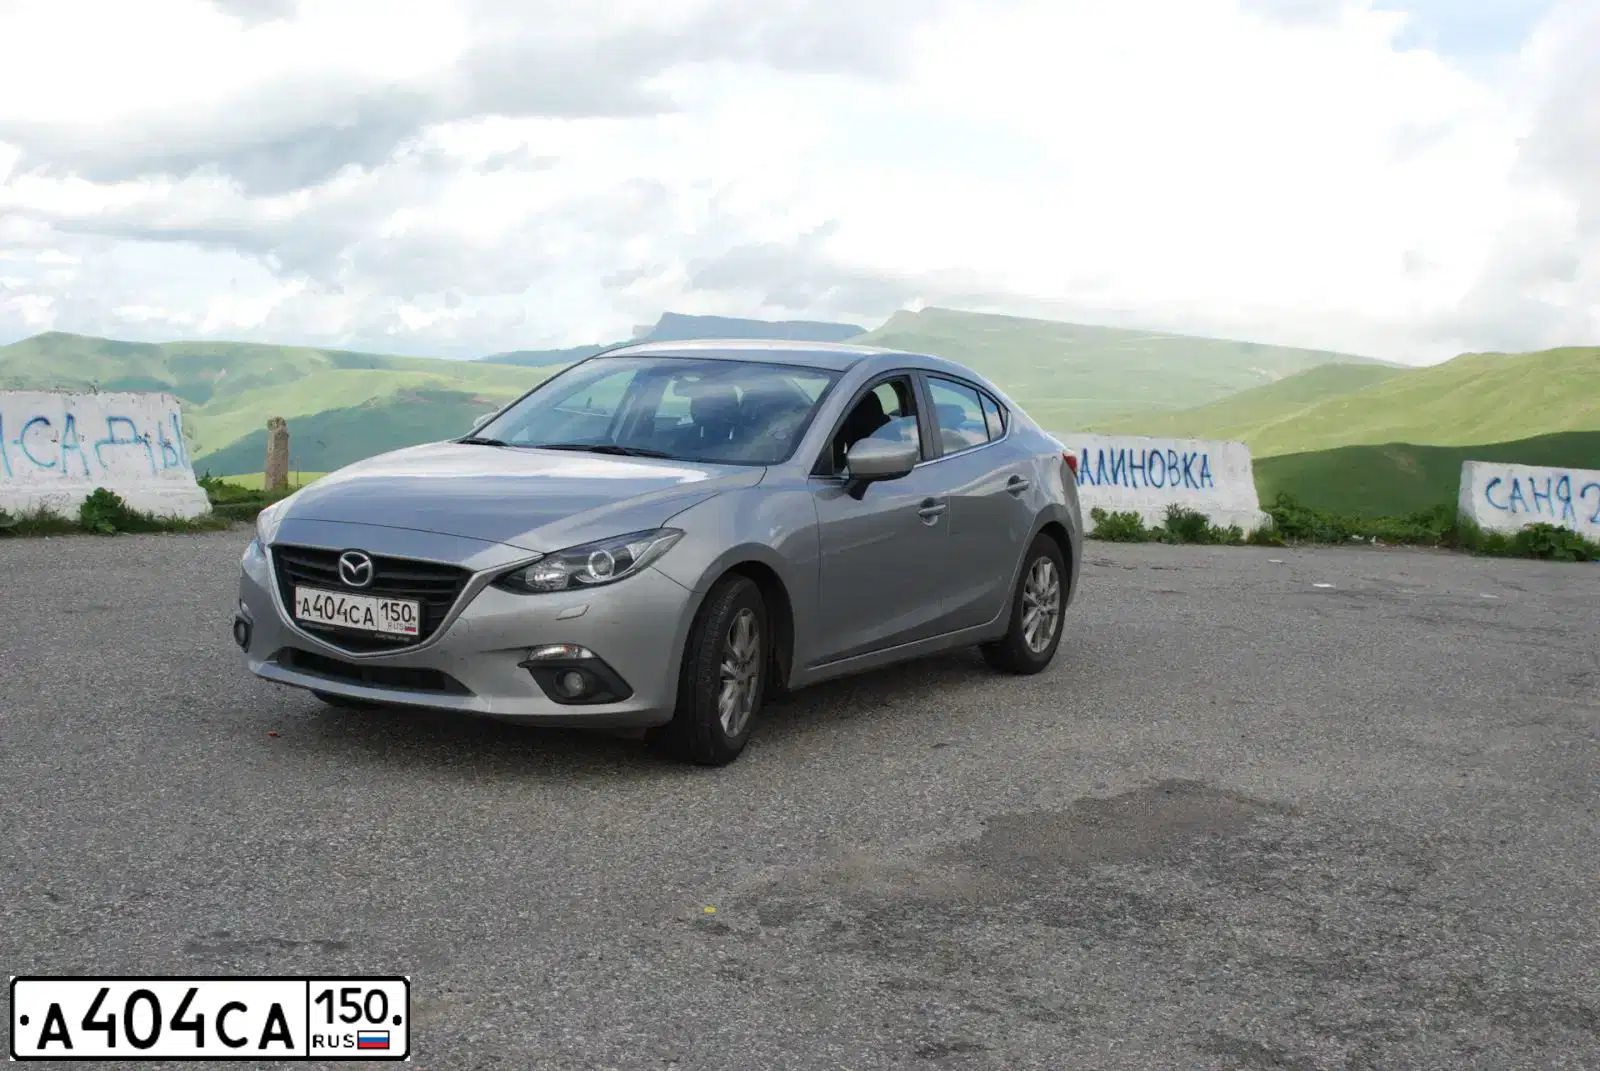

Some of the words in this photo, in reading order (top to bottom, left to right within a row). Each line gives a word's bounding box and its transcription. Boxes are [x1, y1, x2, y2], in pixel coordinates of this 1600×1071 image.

[1076, 448, 1214, 489] АЛИНОВКА
[1485, 475, 1577, 523] САНЯ
[301, 594, 375, 626] А404СА
[380, 602, 412, 622] 150
[387, 622, 404, 631] RUS
